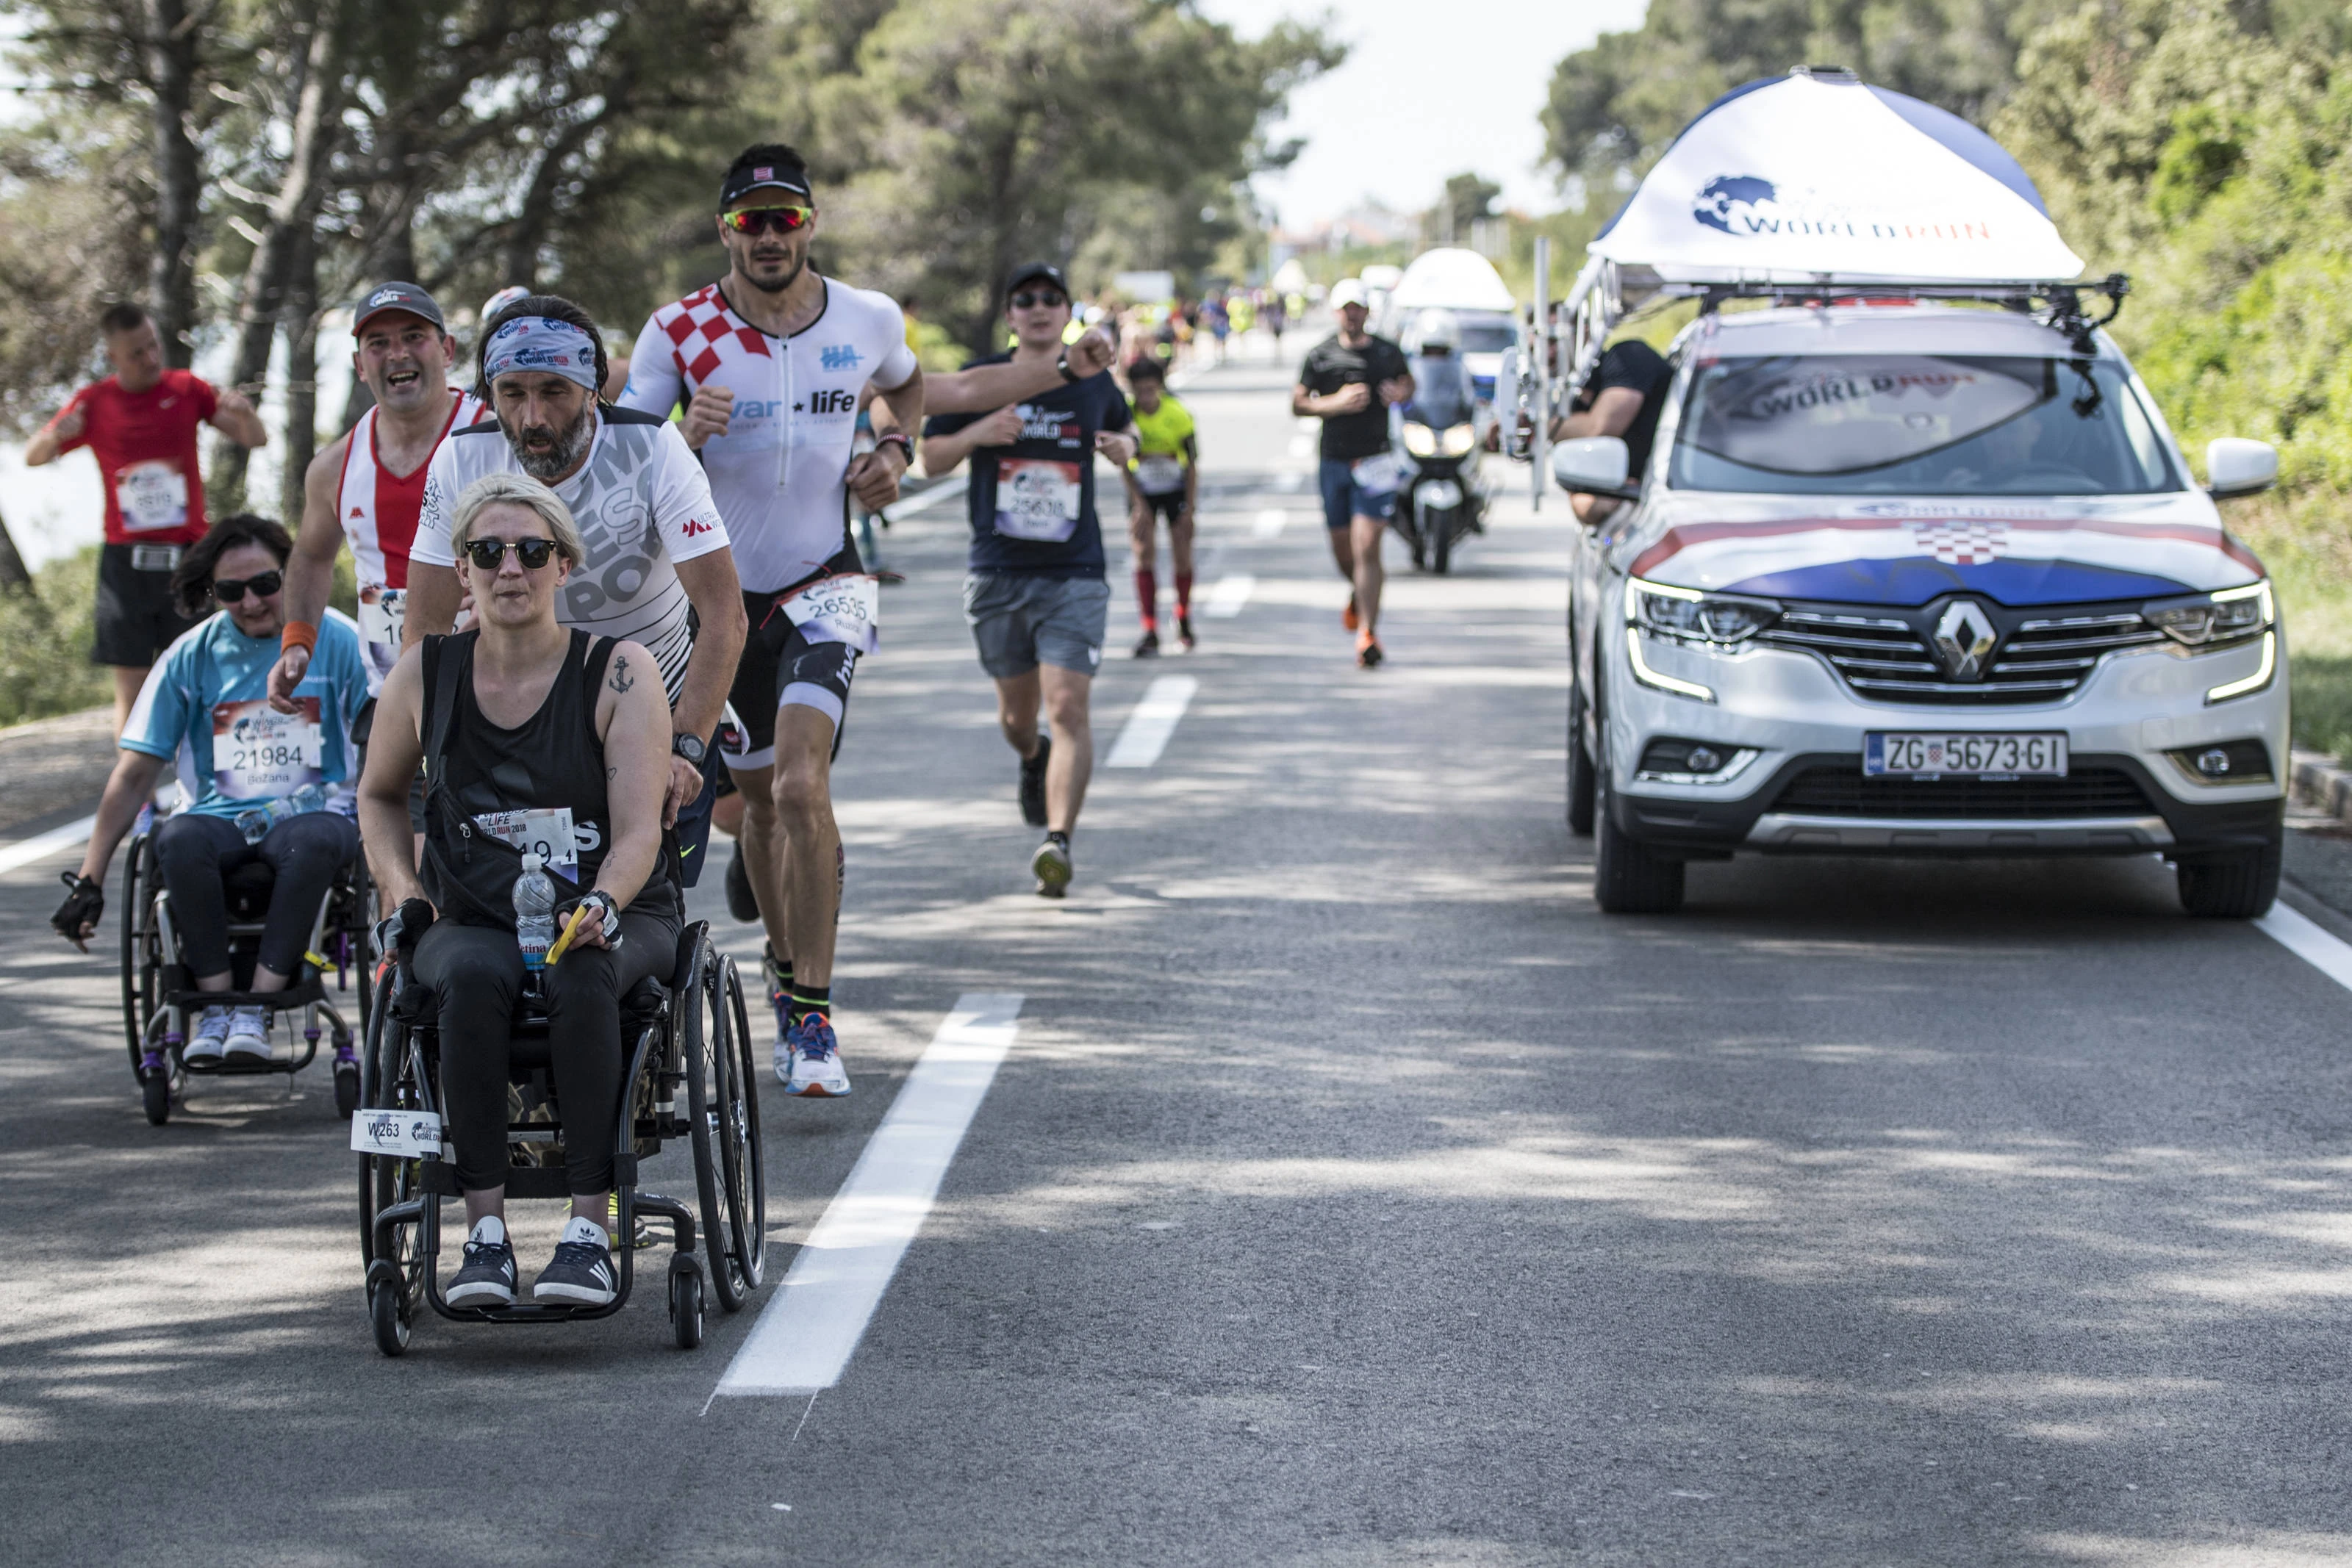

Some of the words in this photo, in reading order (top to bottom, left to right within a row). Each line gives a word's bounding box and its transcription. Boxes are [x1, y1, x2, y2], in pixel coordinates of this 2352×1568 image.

[811, 389, 854, 414] life
[809, 597, 867, 620] 26535
[234, 746, 302, 770] 21984
[1888, 738, 1924, 770] ZG
[488, 815, 511, 827] LIFE
[512, 824, 527, 833] 2018
[368, 1122, 399, 1137] W263
